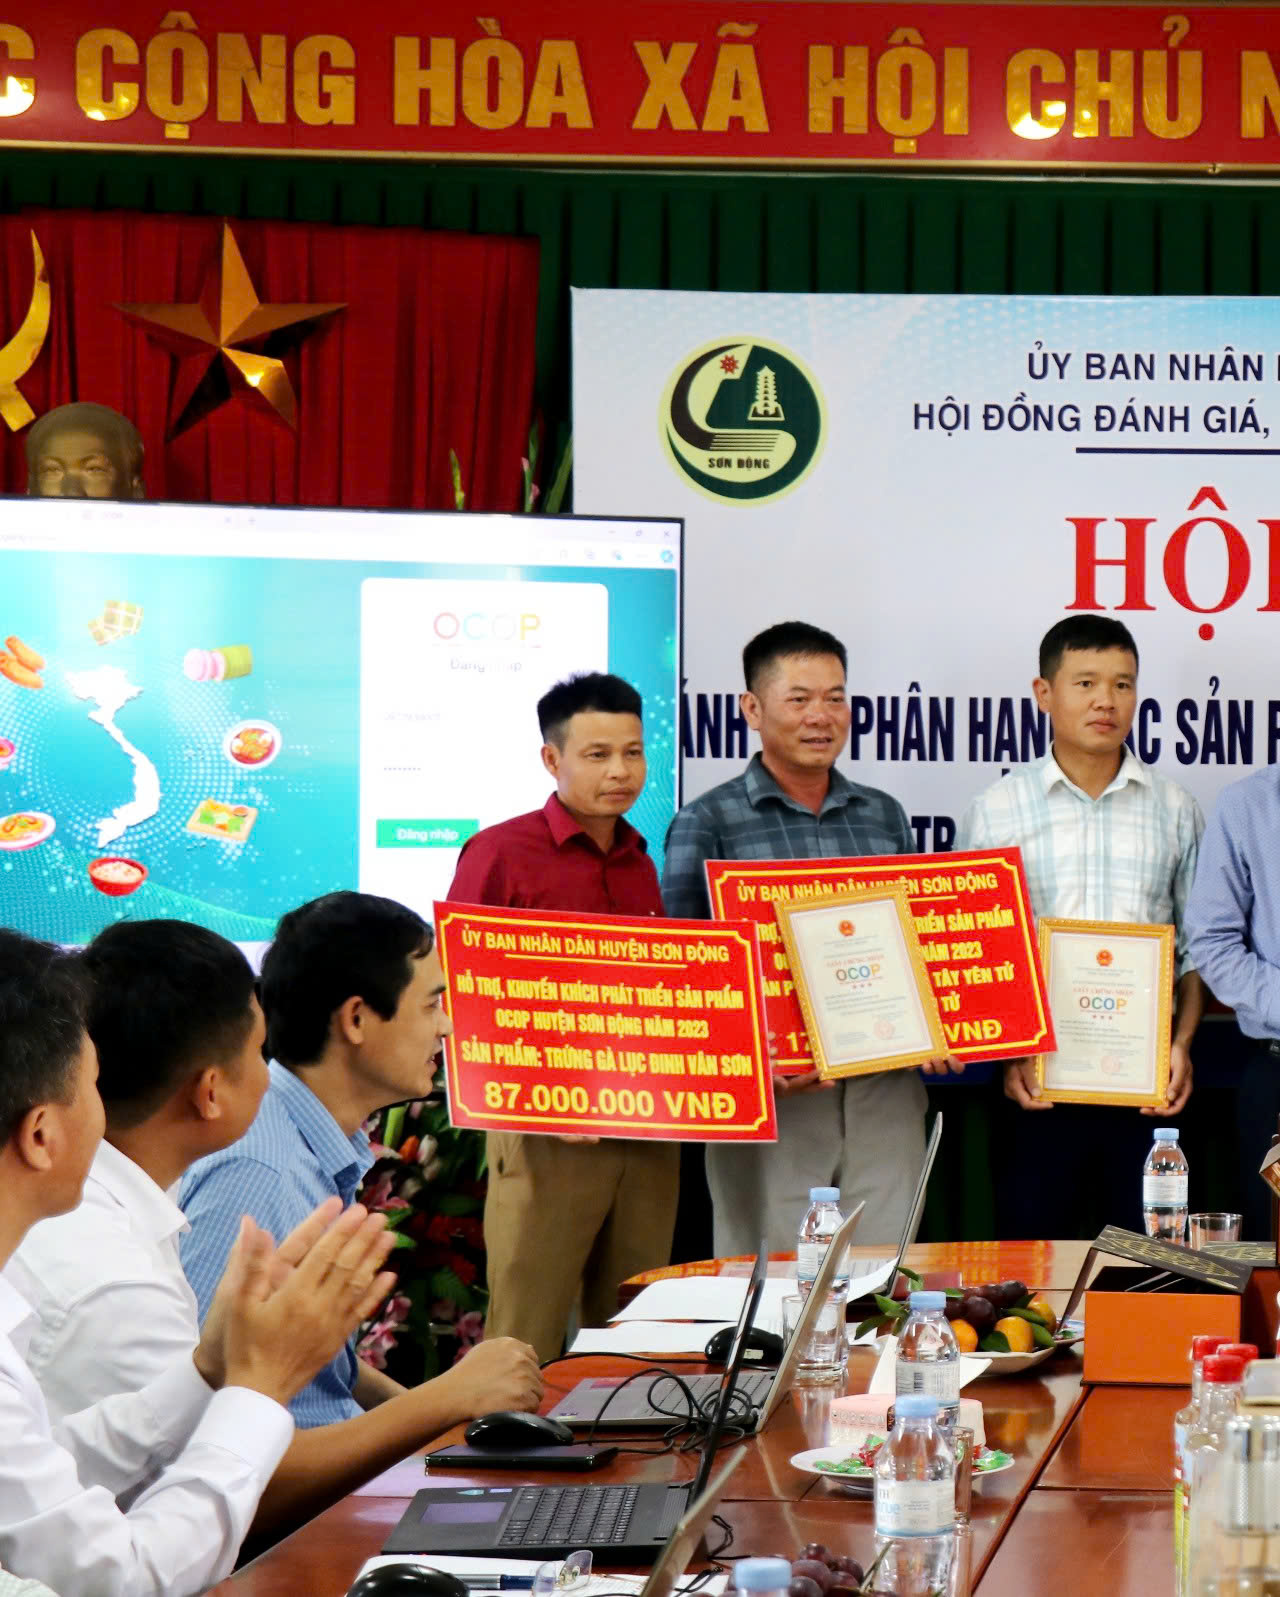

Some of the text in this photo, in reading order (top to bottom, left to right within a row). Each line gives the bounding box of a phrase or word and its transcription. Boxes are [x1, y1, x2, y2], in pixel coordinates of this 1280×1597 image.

[76, 11, 356, 139] CỘNG
[395, 17, 594, 130] HÒA
[633, 22, 770, 132] XÃ
[808, 27, 969, 153] HỘI
[1006, 15, 1203, 139] CHỦ
[1028, 341, 1071, 380] ỦY
[1085, 353, 1155, 381] BAN
[1169, 346, 1263, 382] NHÂN
[914, 396, 969, 437] HỘI
[983, 392, 1081, 432] ĐỒNG
[1095, 397, 1190, 434] ĐÁNH
[1203, 399, 1269, 438] GIÁ,
[681, 678, 749, 759] ÁNH
[851, 682, 955, 762] PHÂN
[969, 696, 1053, 777] HẠN
[1176, 676, 1253, 766] SẢN
[737, 879, 756, 902] ỦY
[760, 883, 791, 902] BAN
[922, 876, 952, 895] SƠN
[956, 872, 998, 893] ĐỘNG
[947, 907, 976, 931] SẢN
[975, 903, 1015, 930] PHẨM
[462, 923, 730, 965] ỦY BAN NHÂN DÂN HUYỆN SƠN ĐỘNG
[951, 940, 983, 961] 2023
[932, 967, 960, 988] TÂY
[962, 964, 993, 985] YÊN
[601, 982, 633, 1005] PHÁT
[676, 983, 703, 1008] SẢN
[496, 1007, 531, 1029] OCOP
[532, 1008, 576, 1036] HUYỆN
[578, 1012, 605, 1034] SƠN
[644, 1014, 675, 1038] NĂM
[677, 1019, 709, 1039] 2023
[942, 1018, 1003, 1043] VNĐ
[461, 1034, 491, 1064] SẢN
[596, 1046, 617, 1071] GÀ
[618, 1051, 647, 1078] LỤC
[687, 1050, 718, 1076] VÂN
[720, 1053, 753, 1077] SƠN
[484, 1081, 736, 1119] 87.000.000 VNĐ
